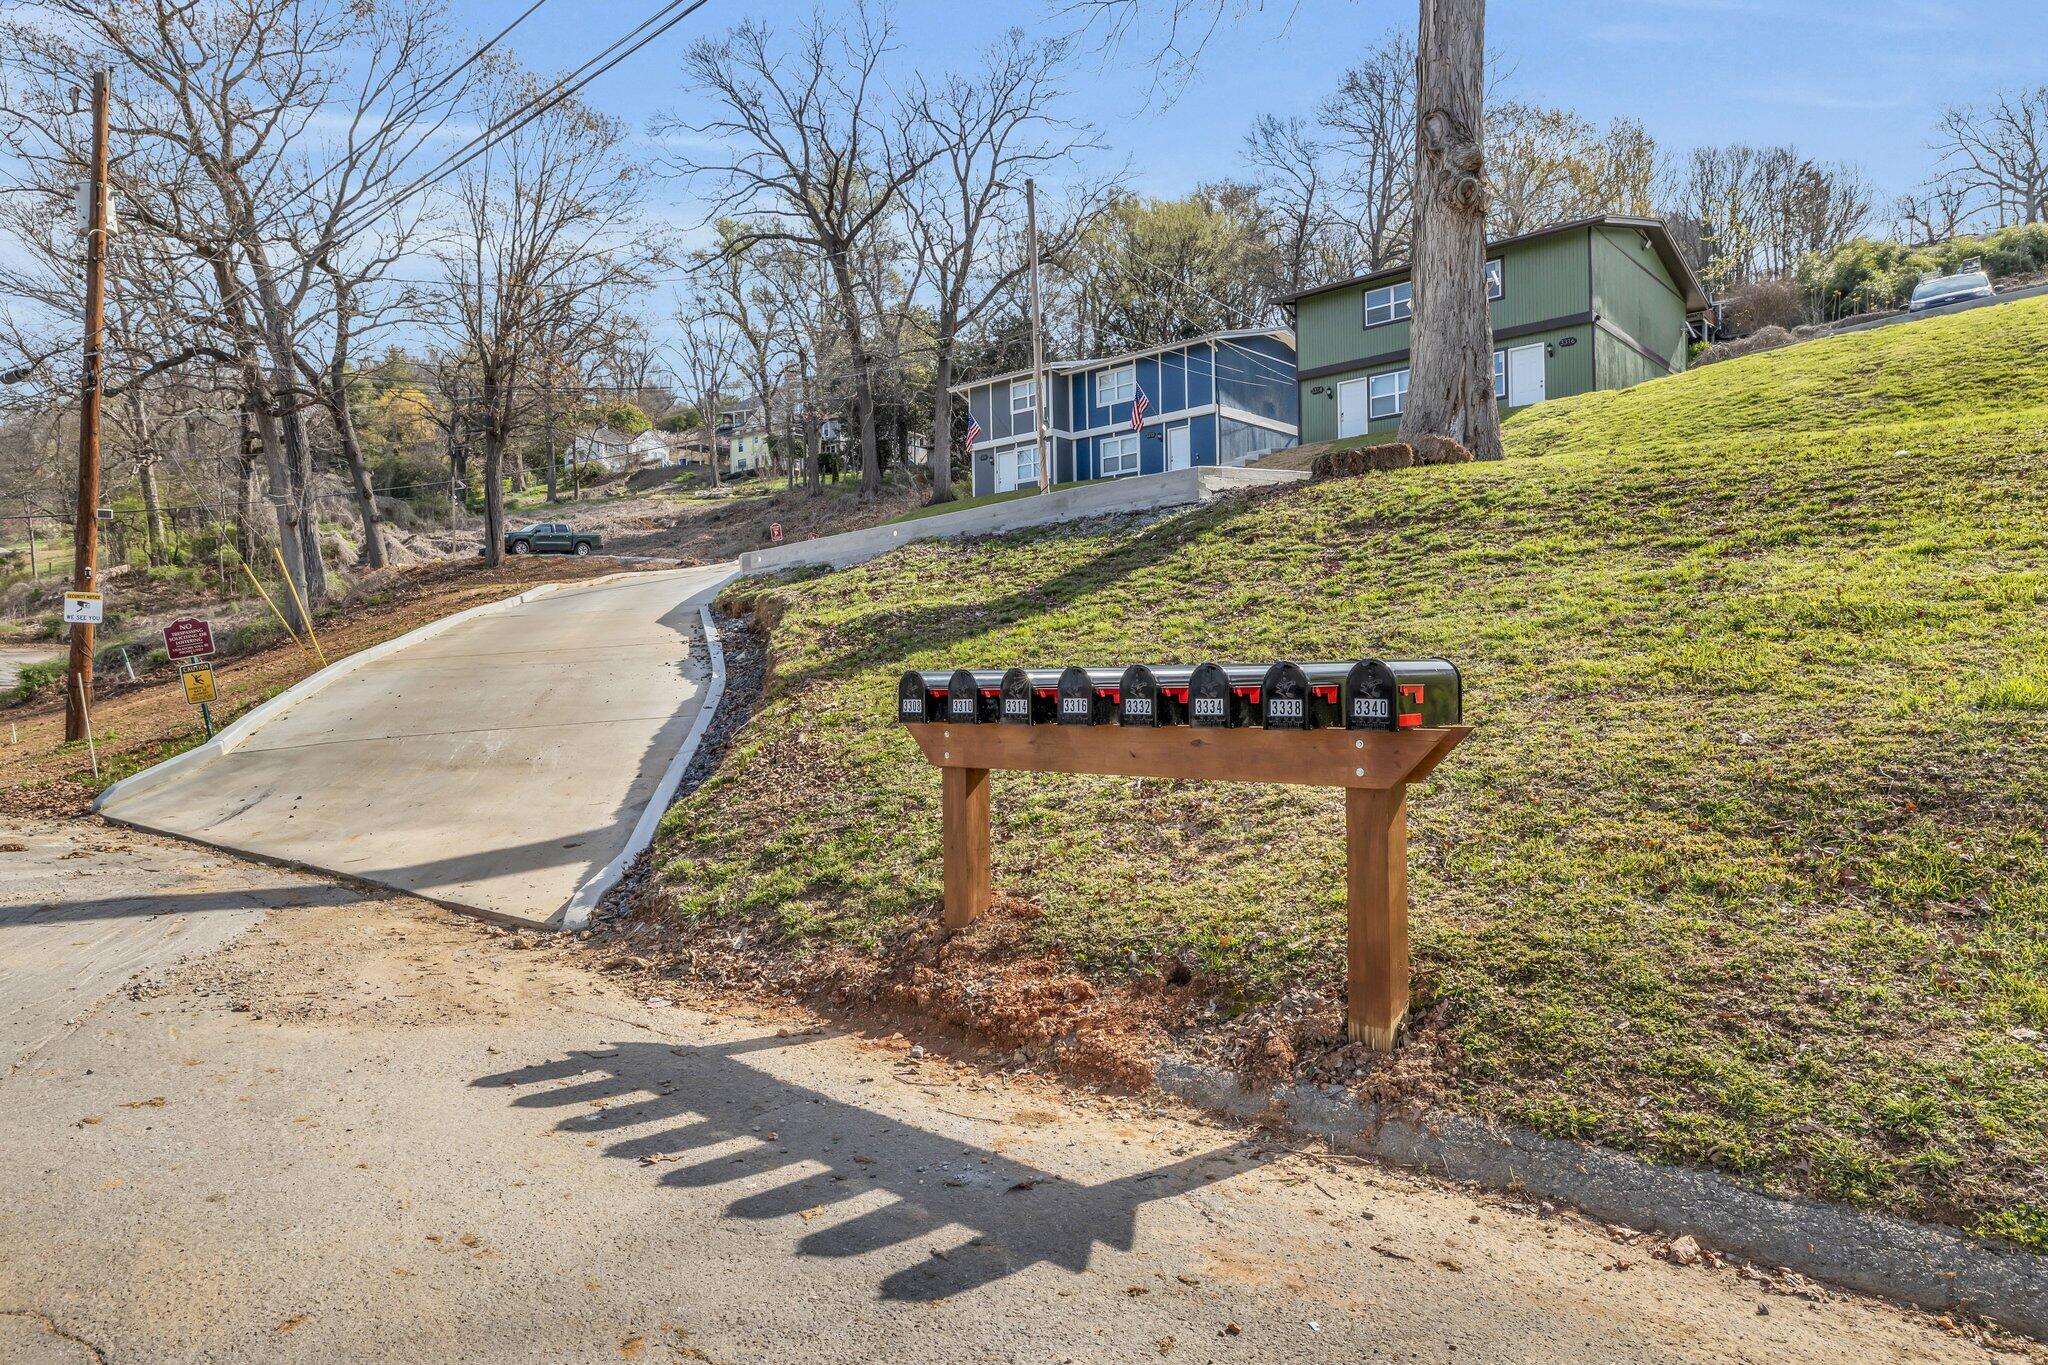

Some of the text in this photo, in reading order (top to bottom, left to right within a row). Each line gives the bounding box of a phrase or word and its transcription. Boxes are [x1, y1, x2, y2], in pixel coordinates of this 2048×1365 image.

[171, 628, 204, 637] TRESPASSING
[183, 664, 209, 672] CAUTION
[903, 700, 921, 711] 3308
[953, 700, 973, 712] 3310
[1006, 700, 1026, 712] 3314
[1064, 699, 1087, 712] 3316
[1127, 700, 1150, 713] 3332
[1197, 700, 1222, 713] 3334
[1272, 701, 1301, 715] 3338
[1355, 700, 1387, 715] 3340
